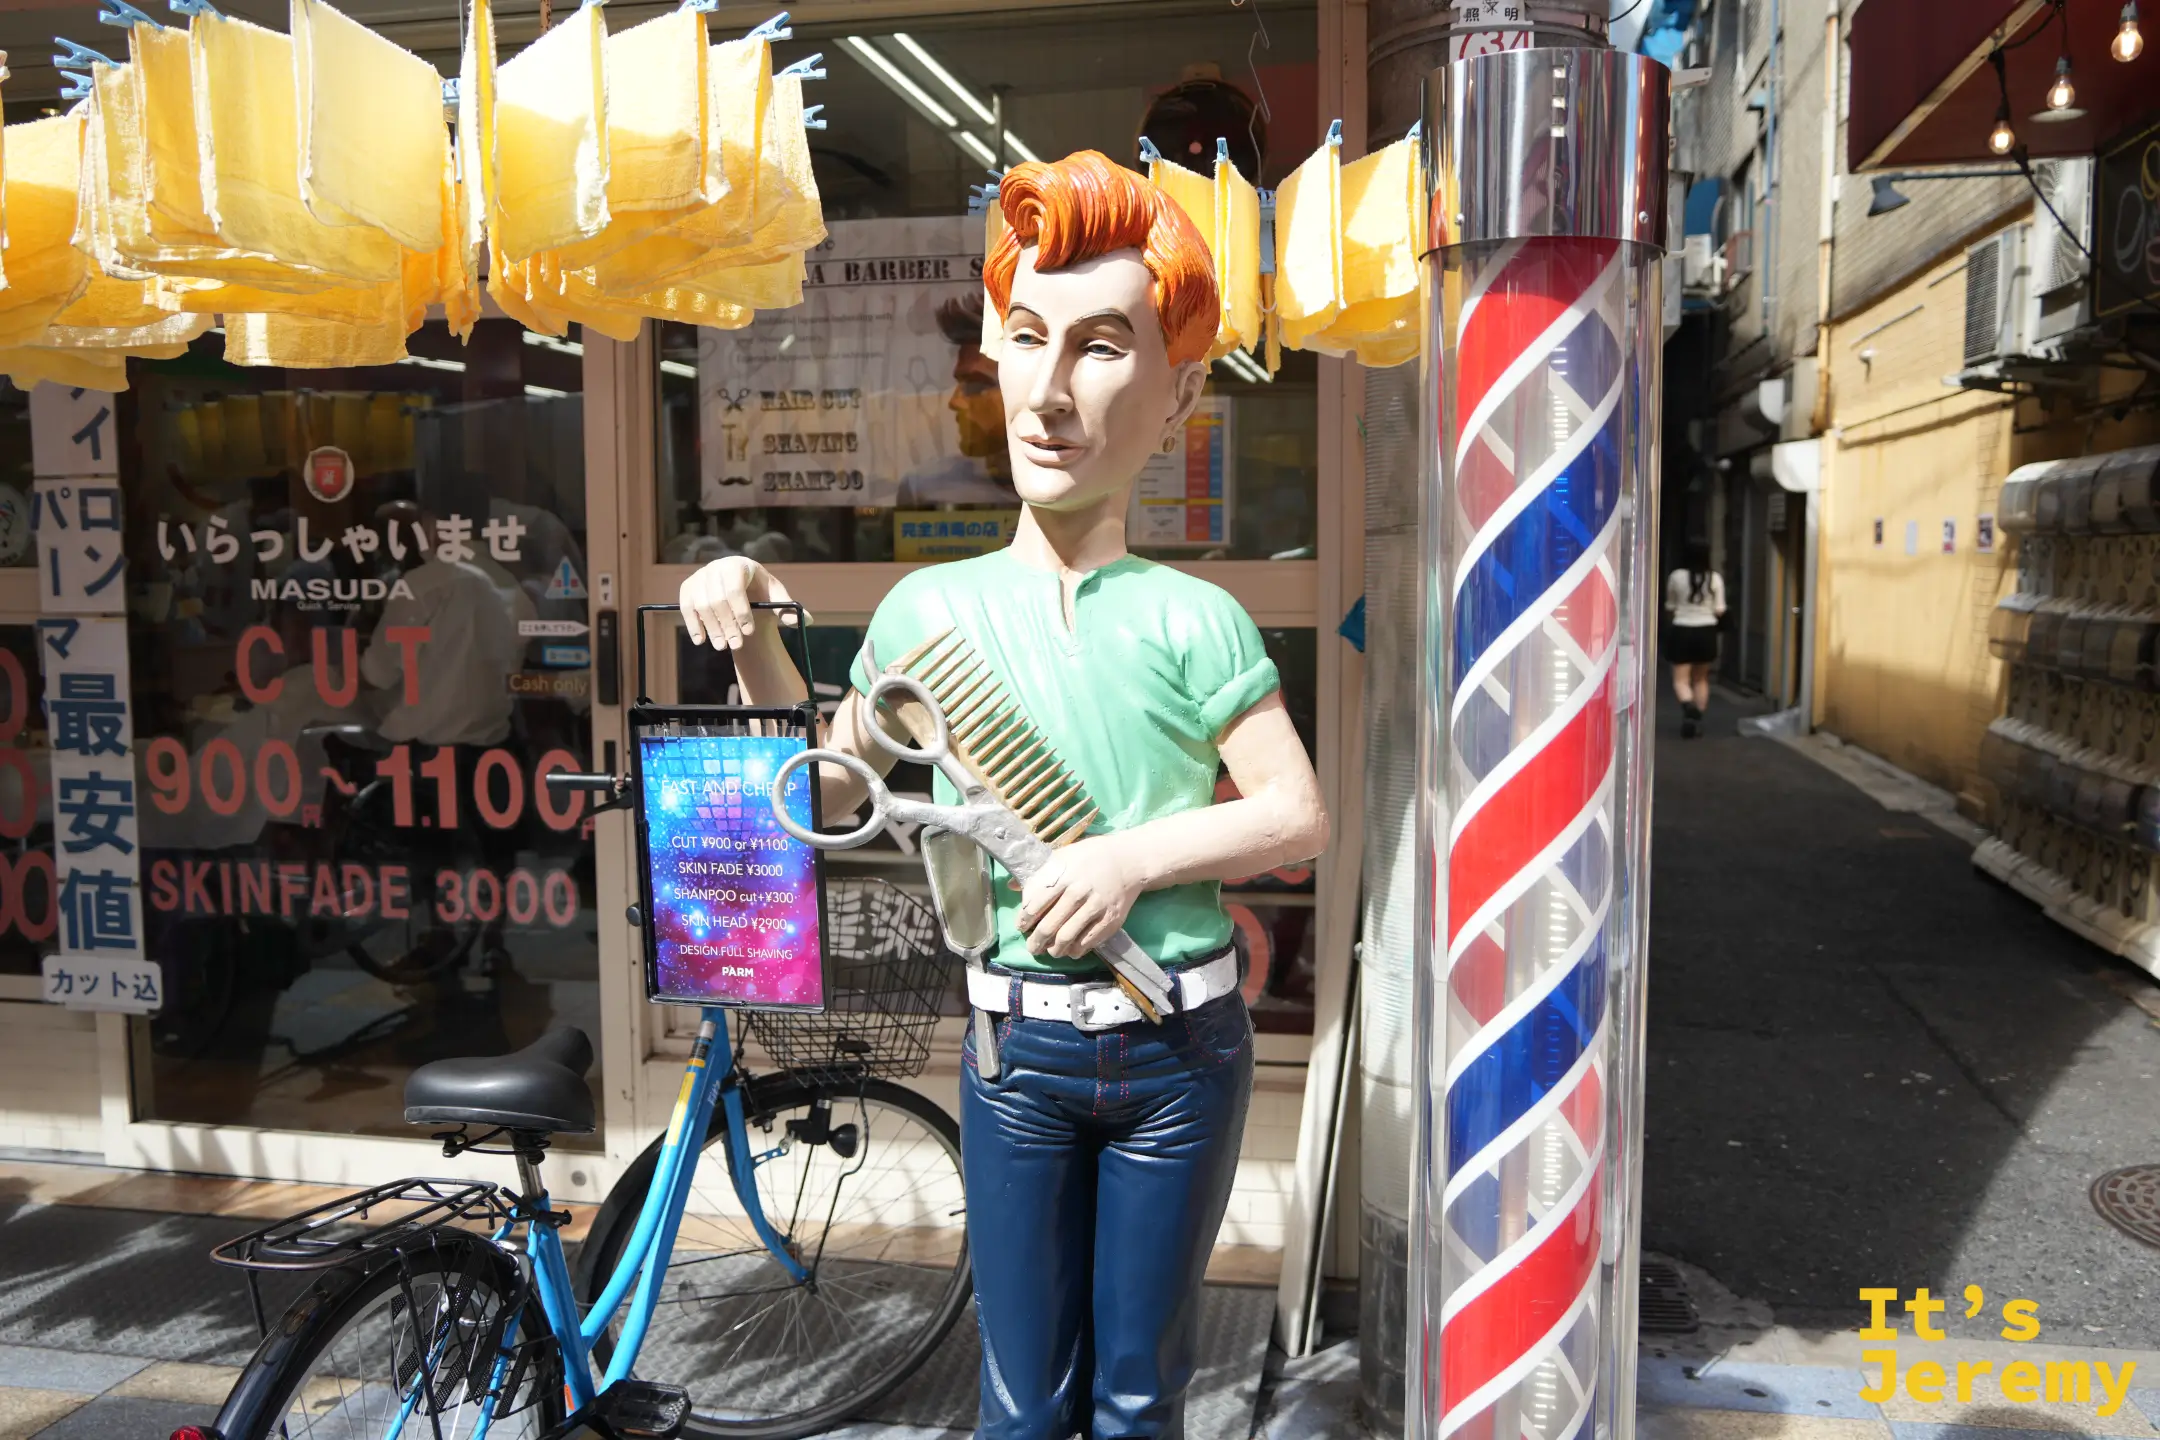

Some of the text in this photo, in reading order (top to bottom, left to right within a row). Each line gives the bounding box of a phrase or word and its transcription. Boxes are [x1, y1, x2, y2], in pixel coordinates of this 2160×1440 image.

[845, 259, 950, 282] BARBER
[760, 388, 861, 411] HAIR CUT
[763, 431, 858, 454] SHAVING
[763, 469, 864, 492] SHAMPOO
[157, 513, 527, 564] いらっしゃいませ
[250, 578, 416, 601] MASUDA
[236, 626, 432, 708] CUT
[509, 674, 588, 695] Cash only
[661, 779, 698, 796] FAST
[703, 780, 738, 797] AND
[50, 673, 137, 951] 最安値
[672, 835, 789, 851] CUT ¥900 or ¥1100
[678, 861, 784, 877] SKIN FADE ¥3000
[150, 859, 410, 919] SKINFADE
[673, 887, 794, 904] SHANPOO cut+¥300
[681, 914, 788, 931] SKIN HEAD ¥2900
[747, 948, 793, 960] SHAVING
[721, 966, 755, 978] PARM
[51, 969, 158, 1001] カット込
